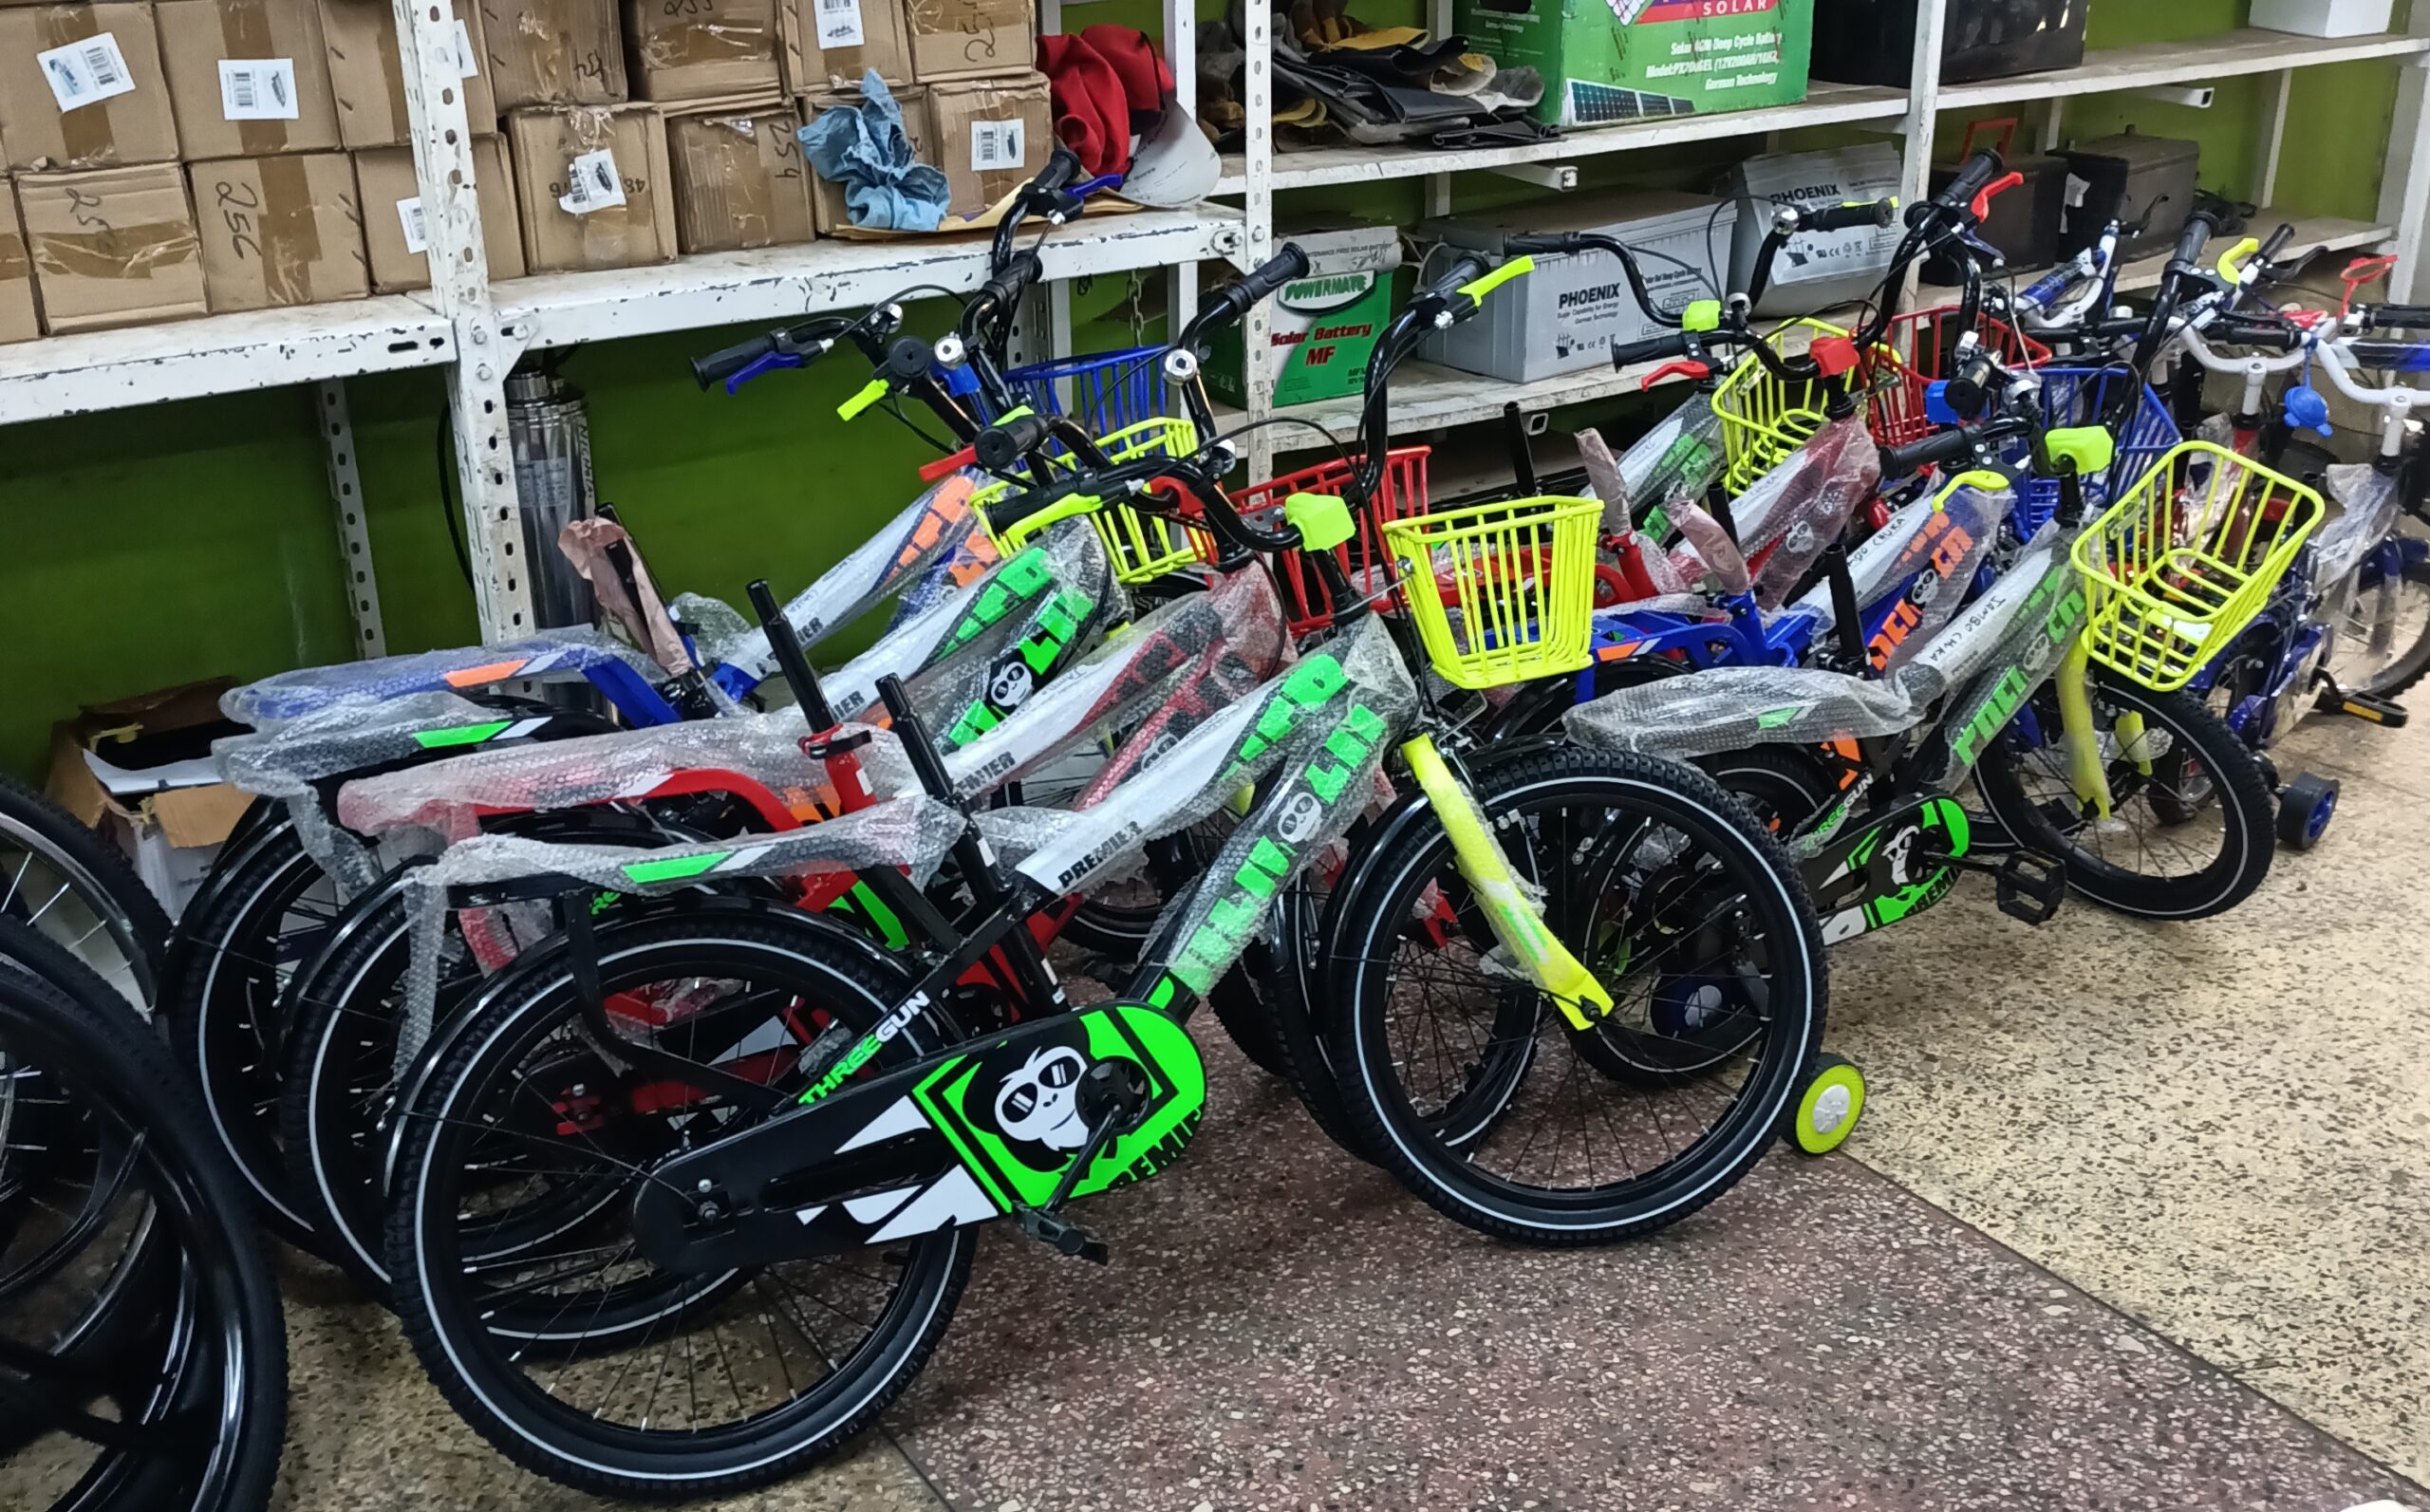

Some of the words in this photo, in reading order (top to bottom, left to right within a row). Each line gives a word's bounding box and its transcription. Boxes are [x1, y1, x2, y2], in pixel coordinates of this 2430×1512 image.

[1703, 0, 1767, 16] SOLAR
[1284, 274, 1368, 302] POWERMATE
[1559, 283, 1621, 309] PHOENIX
[1271, 331, 1309, 346] Solar
[1314, 324, 1373, 342] Battery
[1306, 345, 1336, 366] MF
[1057, 820, 1143, 888] PREMIER
[798, 990, 931, 1105] THREEGUN
